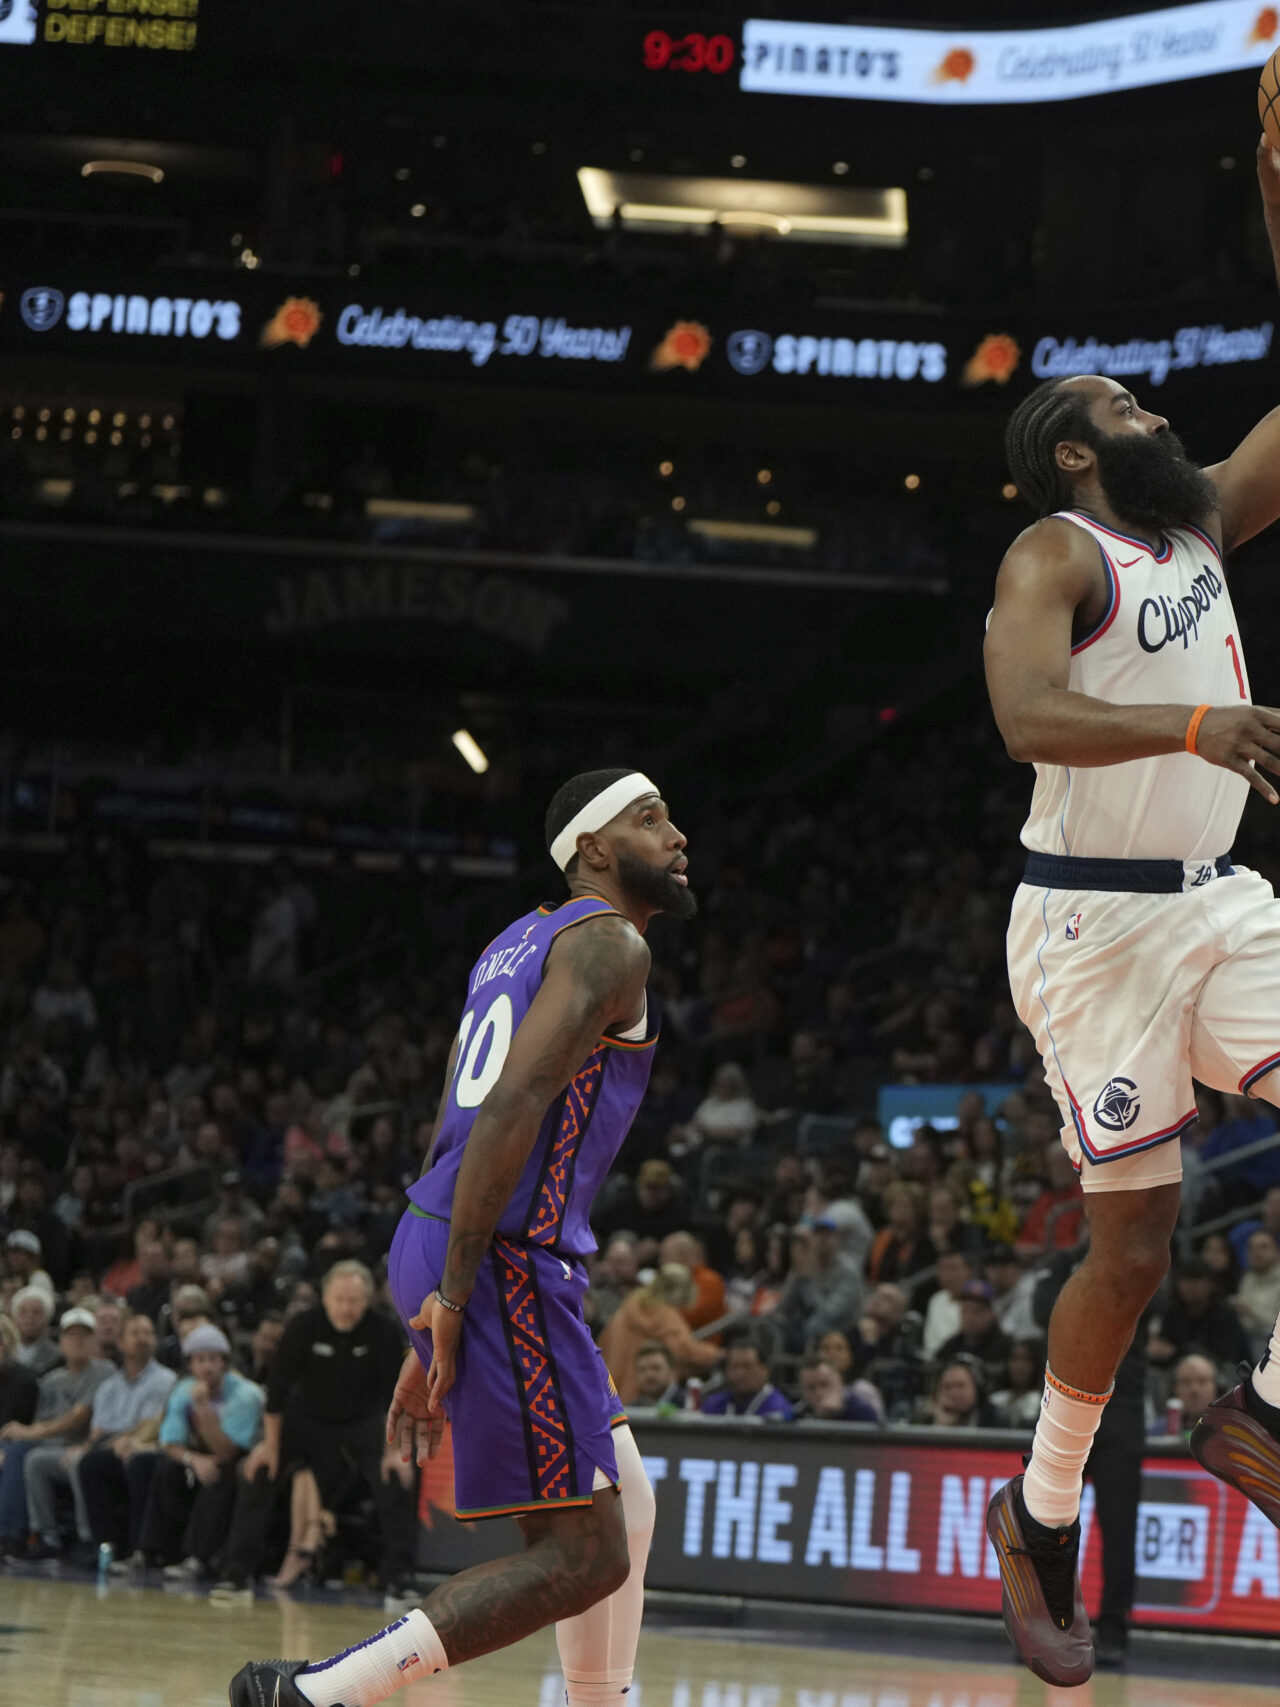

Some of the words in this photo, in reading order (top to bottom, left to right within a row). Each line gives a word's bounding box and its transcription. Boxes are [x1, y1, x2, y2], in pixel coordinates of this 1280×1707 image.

[44, 12, 198, 50] DEFENSE!
[643, 30, 735, 75] 9:30
[66, 291, 242, 340] SPINATO'S
[336, 303, 498, 367] Celebrating
[499, 314, 541, 356] 50
[538, 316, 633, 363] Years!
[772, 333, 947, 383] SPINATO'S
[1031, 336, 1173, 387] Celebrating
[1200, 320, 1275, 367] Years!
[1137, 563, 1223, 654] Clippers
[1225, 633, 1248, 700] 1
[679, 1457, 798, 1565] THE
[804, 1466, 921, 1575] ALL
